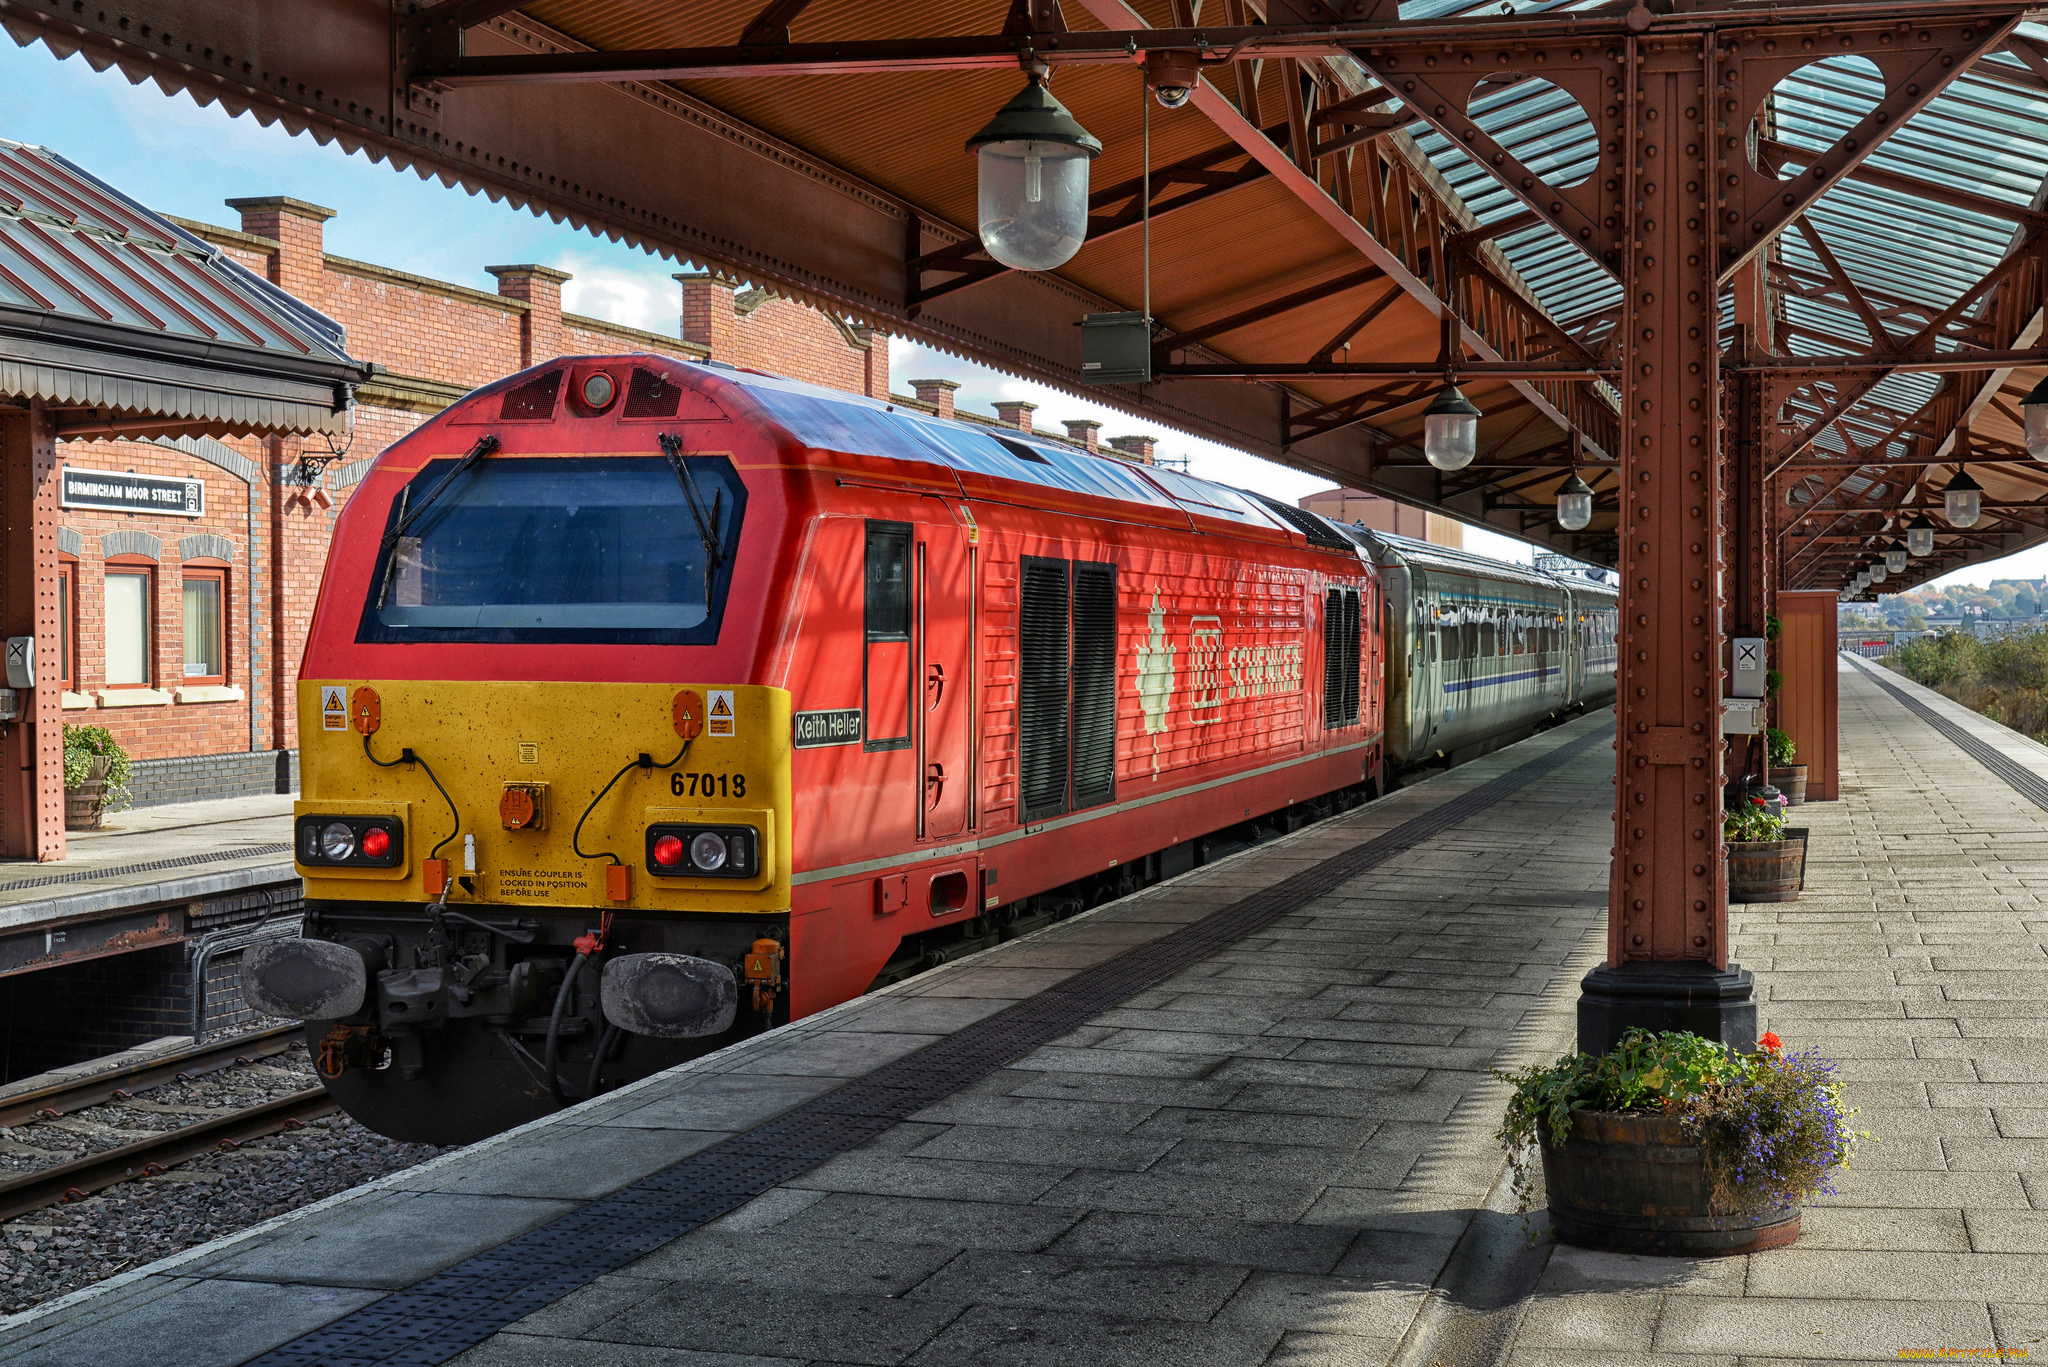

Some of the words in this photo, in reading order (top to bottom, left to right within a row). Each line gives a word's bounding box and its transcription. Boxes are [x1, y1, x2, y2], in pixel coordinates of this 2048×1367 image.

[68, 481, 123, 498] BIRMINGHAM
[125, 486, 149, 500] MOOR
[152, 489, 182, 503] STREET
[1228, 646, 1301, 699] SCHENKER
[797, 713, 827, 740] Keith
[829, 711, 860, 738] Heller
[670, 772, 746, 798] 67018
[499, 869, 532, 877] ENSURE
[534, 870, 573, 878] COUPLER
[574, 871, 583, 879] IS
[500, 879, 534, 887] LOCKED
[536, 880, 545, 888] IN
[547, 881, 588, 889] POSITION
[500, 888, 532, 897] BEFORE
[534, 890, 550, 898] USE
